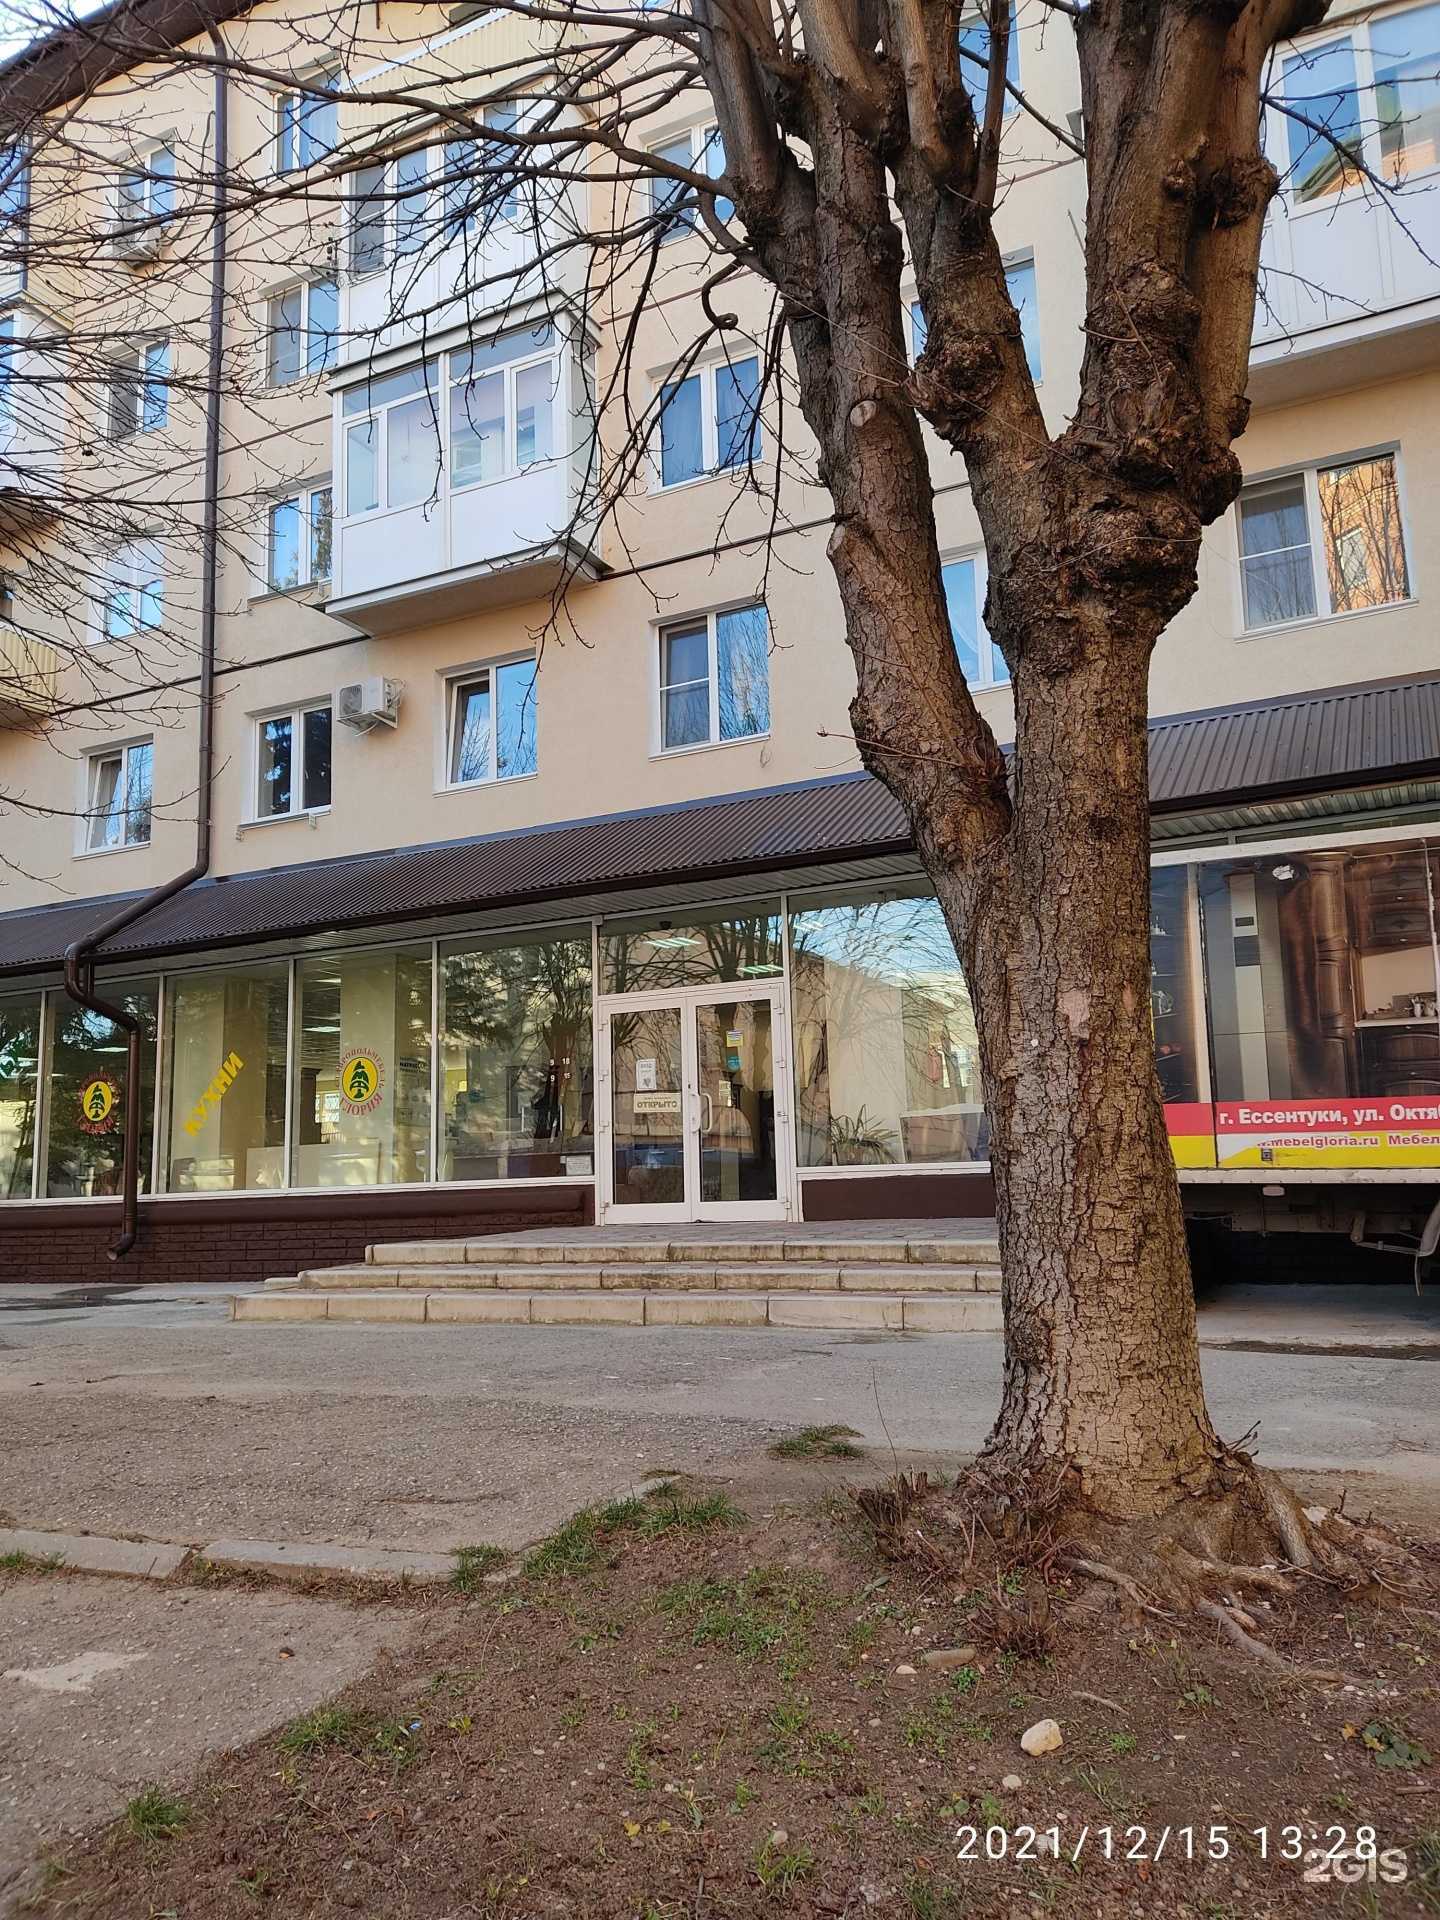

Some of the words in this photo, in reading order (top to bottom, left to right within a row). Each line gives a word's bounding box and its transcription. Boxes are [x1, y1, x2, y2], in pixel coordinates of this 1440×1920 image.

[637, 1100, 678, 1109] ОТКРЫТО
[1219, 1112, 1234, 1125] г.
[1239, 1108, 1349, 1127] Ессентуки,
[1352, 1108, 1385, 1126] ул.
[1390, 1103, 1440, 1121] Октя
